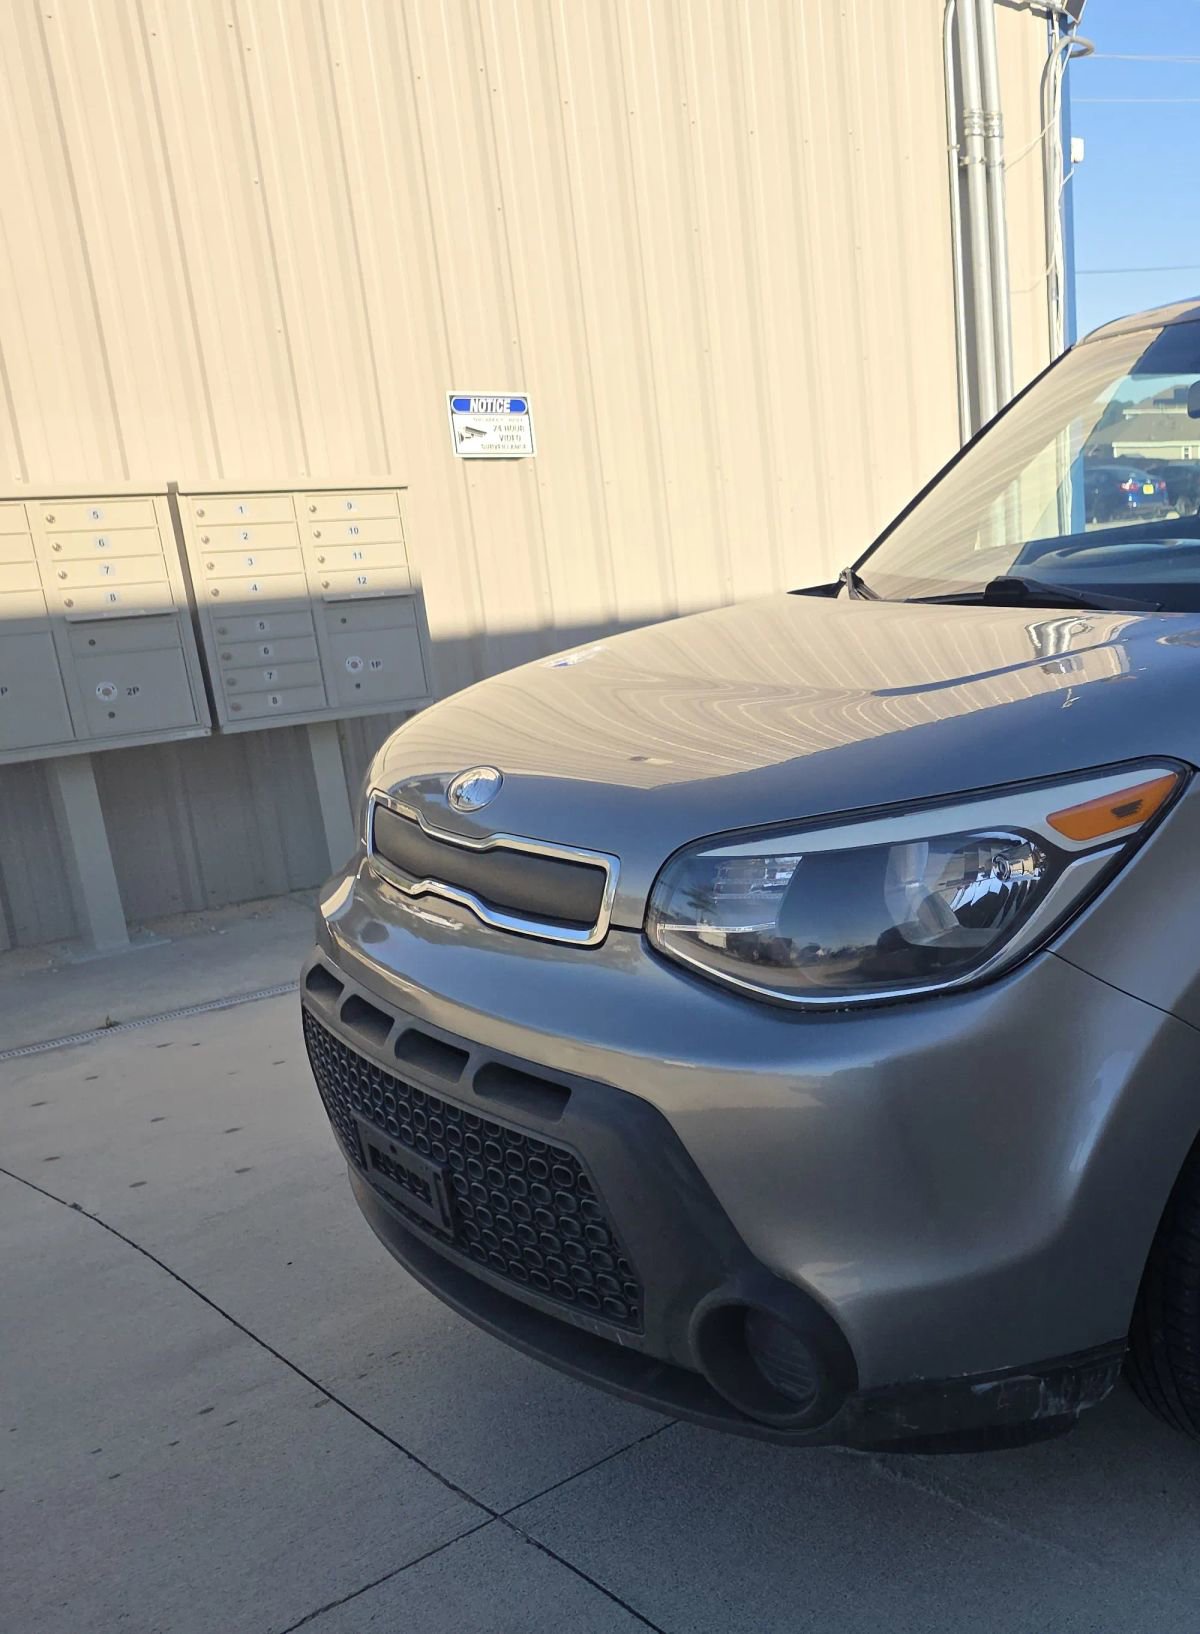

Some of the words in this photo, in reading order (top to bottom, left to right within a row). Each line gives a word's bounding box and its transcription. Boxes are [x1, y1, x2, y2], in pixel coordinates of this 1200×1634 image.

[470, 398, 511, 414] NOTICE
[349, 527, 359, 535] 10
[353, 551, 362, 560] 11
[357, 577, 367, 585] 12
[370, 660, 381, 668] 1P
[126, 687, 140, 695] 2P
